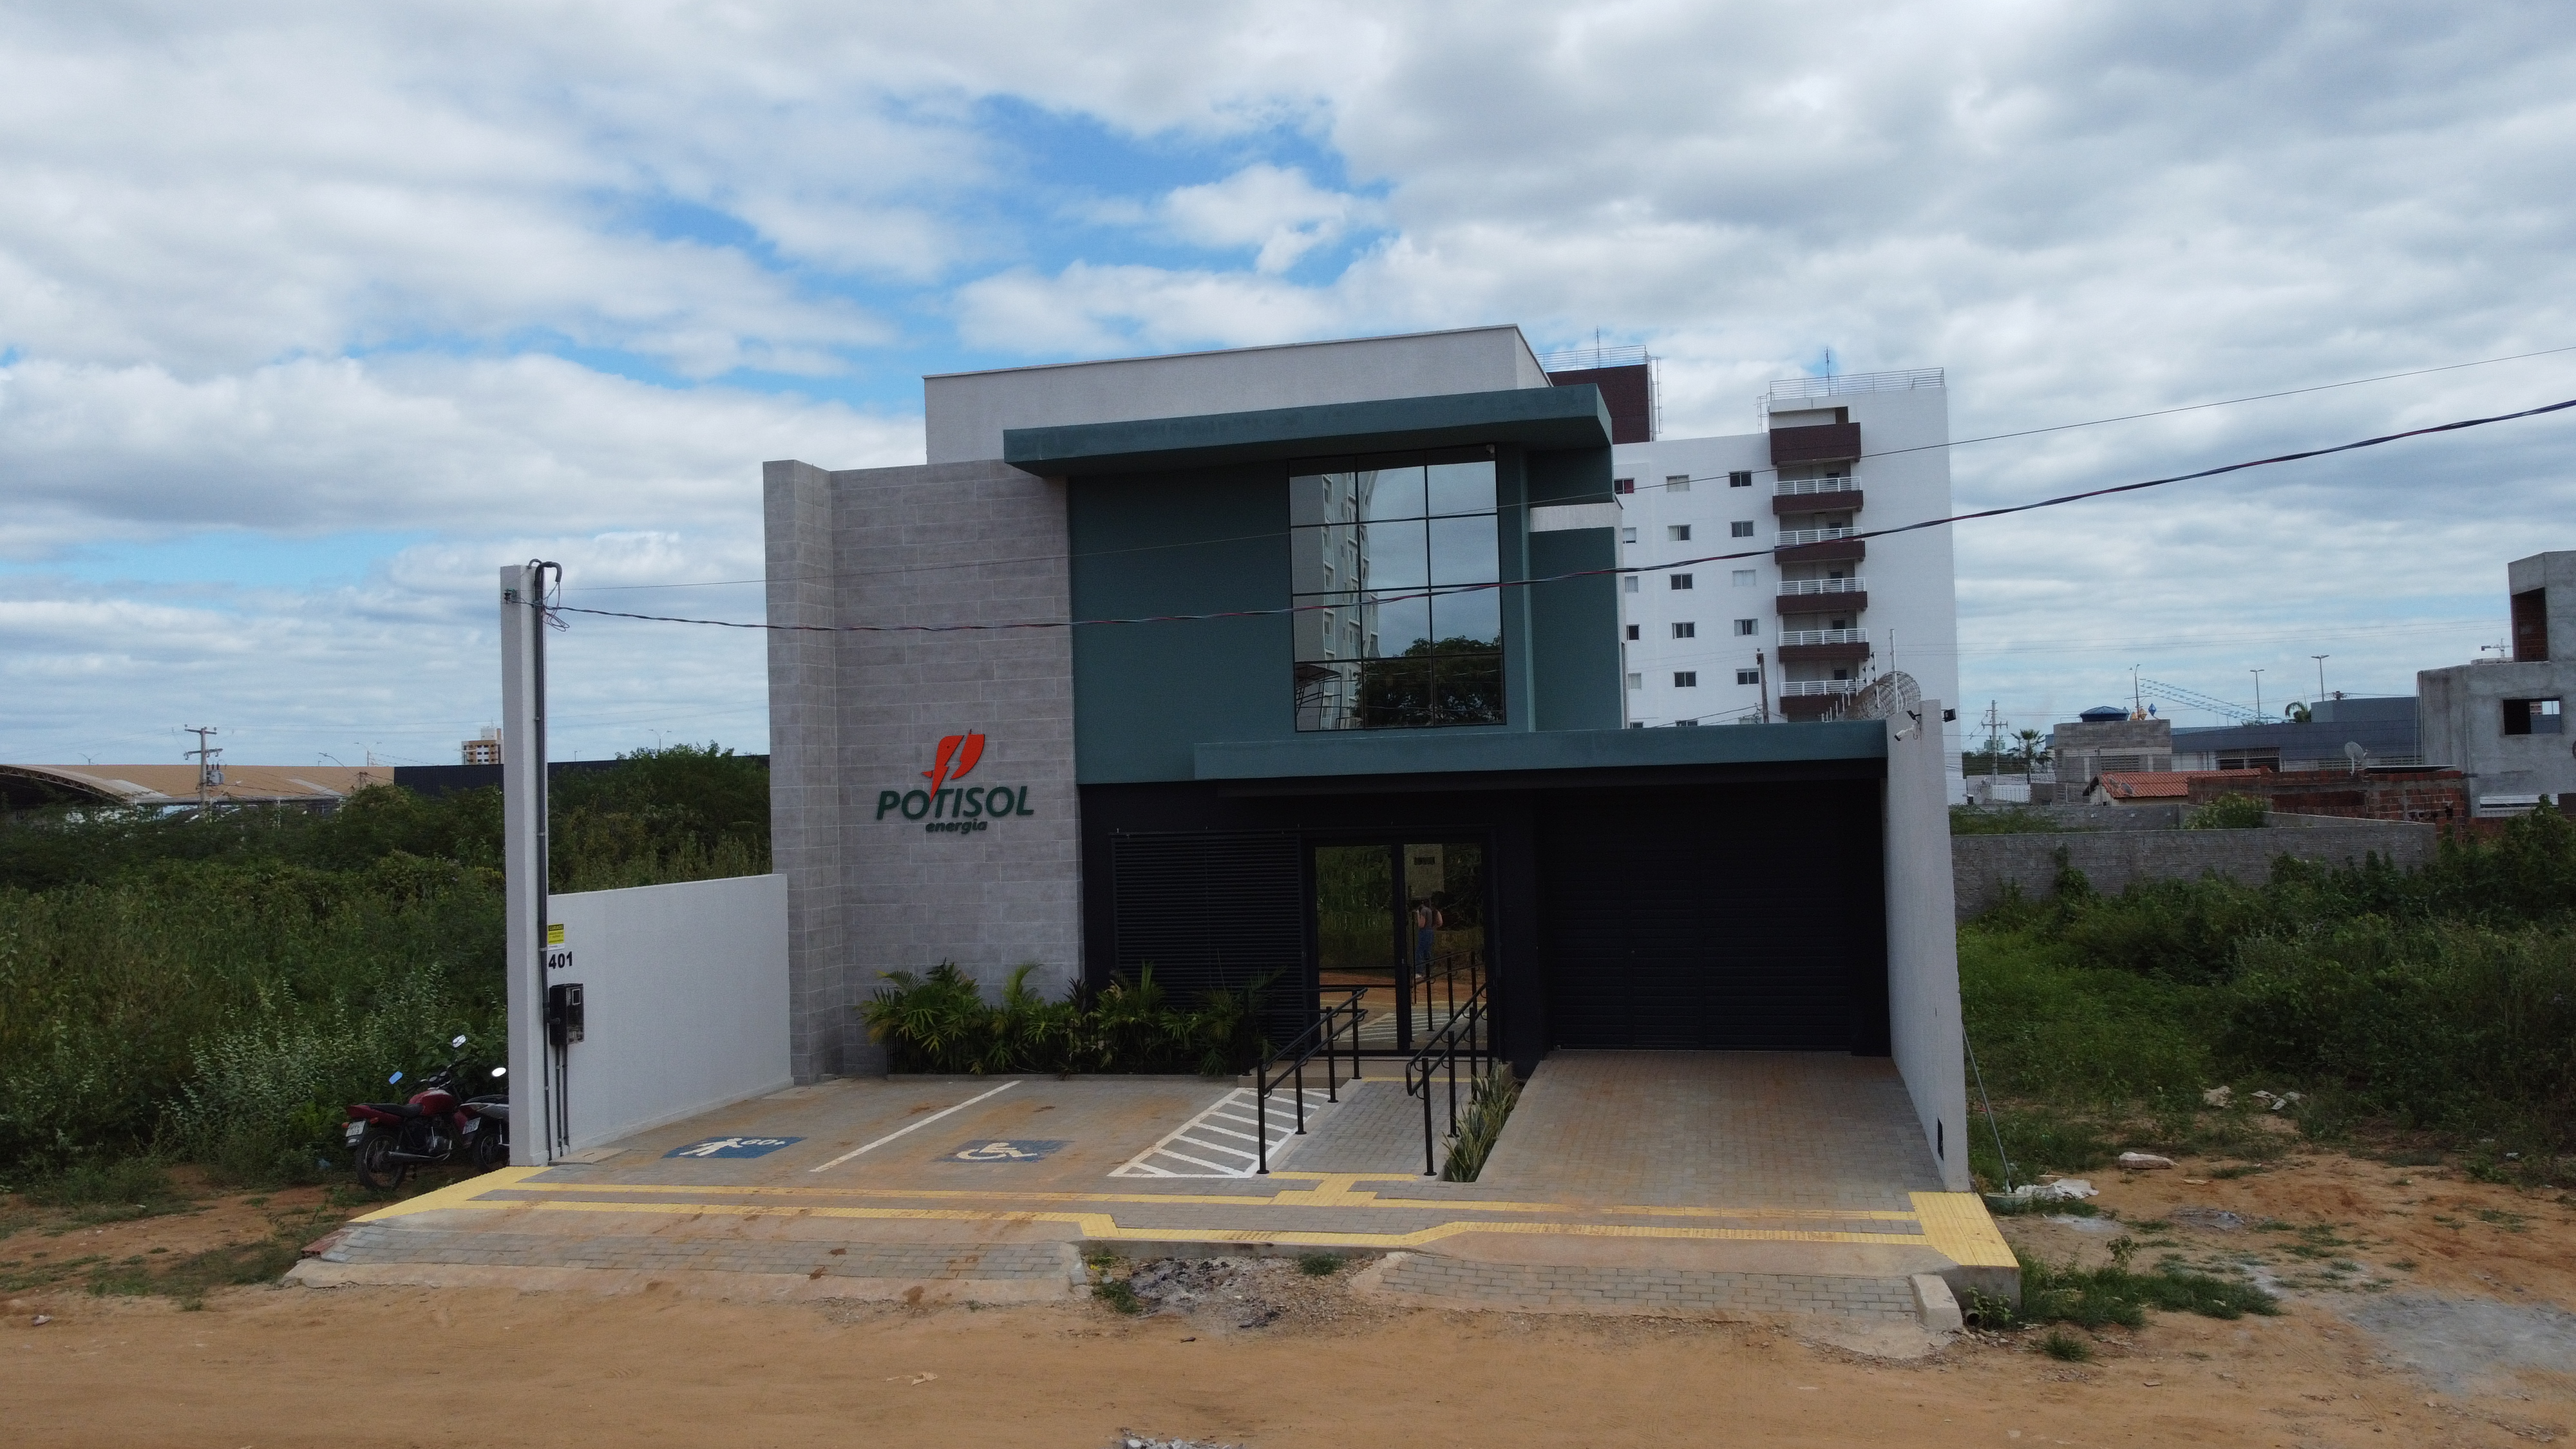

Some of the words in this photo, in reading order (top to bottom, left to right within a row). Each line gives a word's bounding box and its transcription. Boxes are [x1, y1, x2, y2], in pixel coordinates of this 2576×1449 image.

[876, 786, 1034, 820] POTISOL
[925, 819, 988, 835] energia
[549, 951, 573, 969] 401
